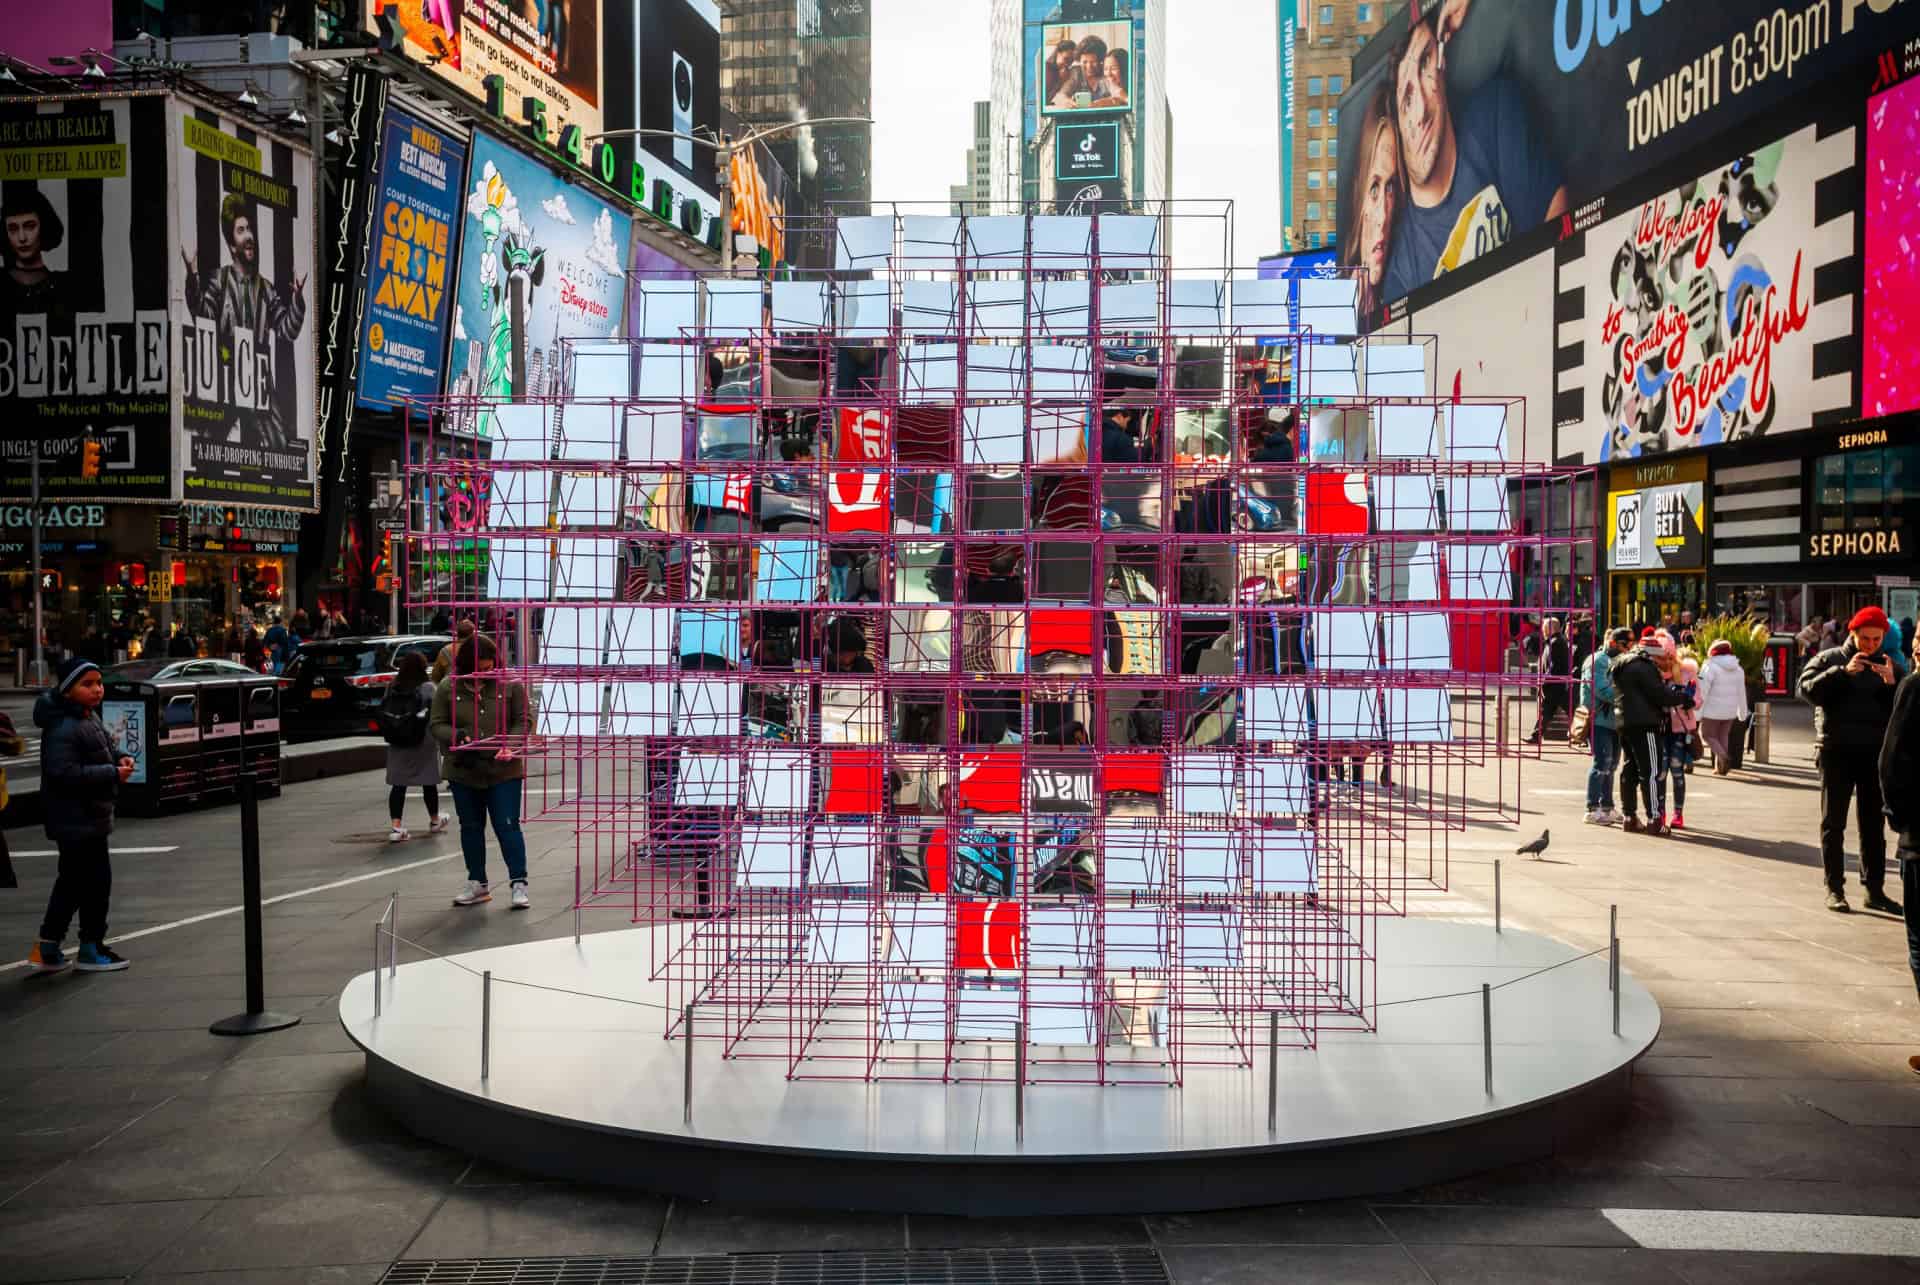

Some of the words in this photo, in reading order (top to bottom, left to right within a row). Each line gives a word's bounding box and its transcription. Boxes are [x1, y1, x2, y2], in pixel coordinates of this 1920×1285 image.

[486, 9, 498, 30] for
[500, 23, 512, 39] an
[510, 12, 541, 47] making
[1553, 0, 1664, 73] Ou
[464, 25, 485, 53] Then
[487, 45, 498, 60] go
[500, 50, 519, 74] back
[520, 65, 529, 81] to
[530, 75, 543, 92] not
[545, 84, 571, 111] talking.
[1626, 44, 1724, 151] TONIGHT
[1731, 0, 1829, 94] 8:30pm
[26, 120, 51, 140] CAN
[57, 116, 109, 138] REALLY
[482, 74, 615, 183] 1540
[5, 152, 32, 174] YOU
[38, 152, 71, 172] FEEL
[401, 141, 418, 165] BEST
[419, 151, 447, 180] MUSICAL
[1073, 152, 1102, 161] TikTok
[386, 187, 406, 204] COME
[408, 196, 440, 217] TOGETHER
[442, 210, 451, 221] AT
[1575, 196, 1605, 219] MARRIOTT
[384, 201, 449, 257] COME
[1638, 197, 1666, 246] We
[1661, 194, 1725, 269] Belong
[379, 234, 446, 290] FROM
[559, 259, 608, 293] WELCOME
[374, 274, 443, 321] AWAY
[560, 277, 588, 317] Disney
[1602, 303, 1625, 343] to
[1623, 304, 1688, 384] Something
[1672, 249, 1809, 436] Beautiful
[182, 316, 271, 411] JUICE
[1838, 430, 1888, 449] SEPHORA
[0, 505, 104, 528] GGAGE
[236, 507, 301, 531] LUGGAGE
[1655, 491, 1676, 513] BUY
[1655, 514, 1675, 536] GET
[1677, 514, 1683, 536] 1
[255, 543, 279, 552] SONY
[1810, 531, 1900, 556] SEPHORA
